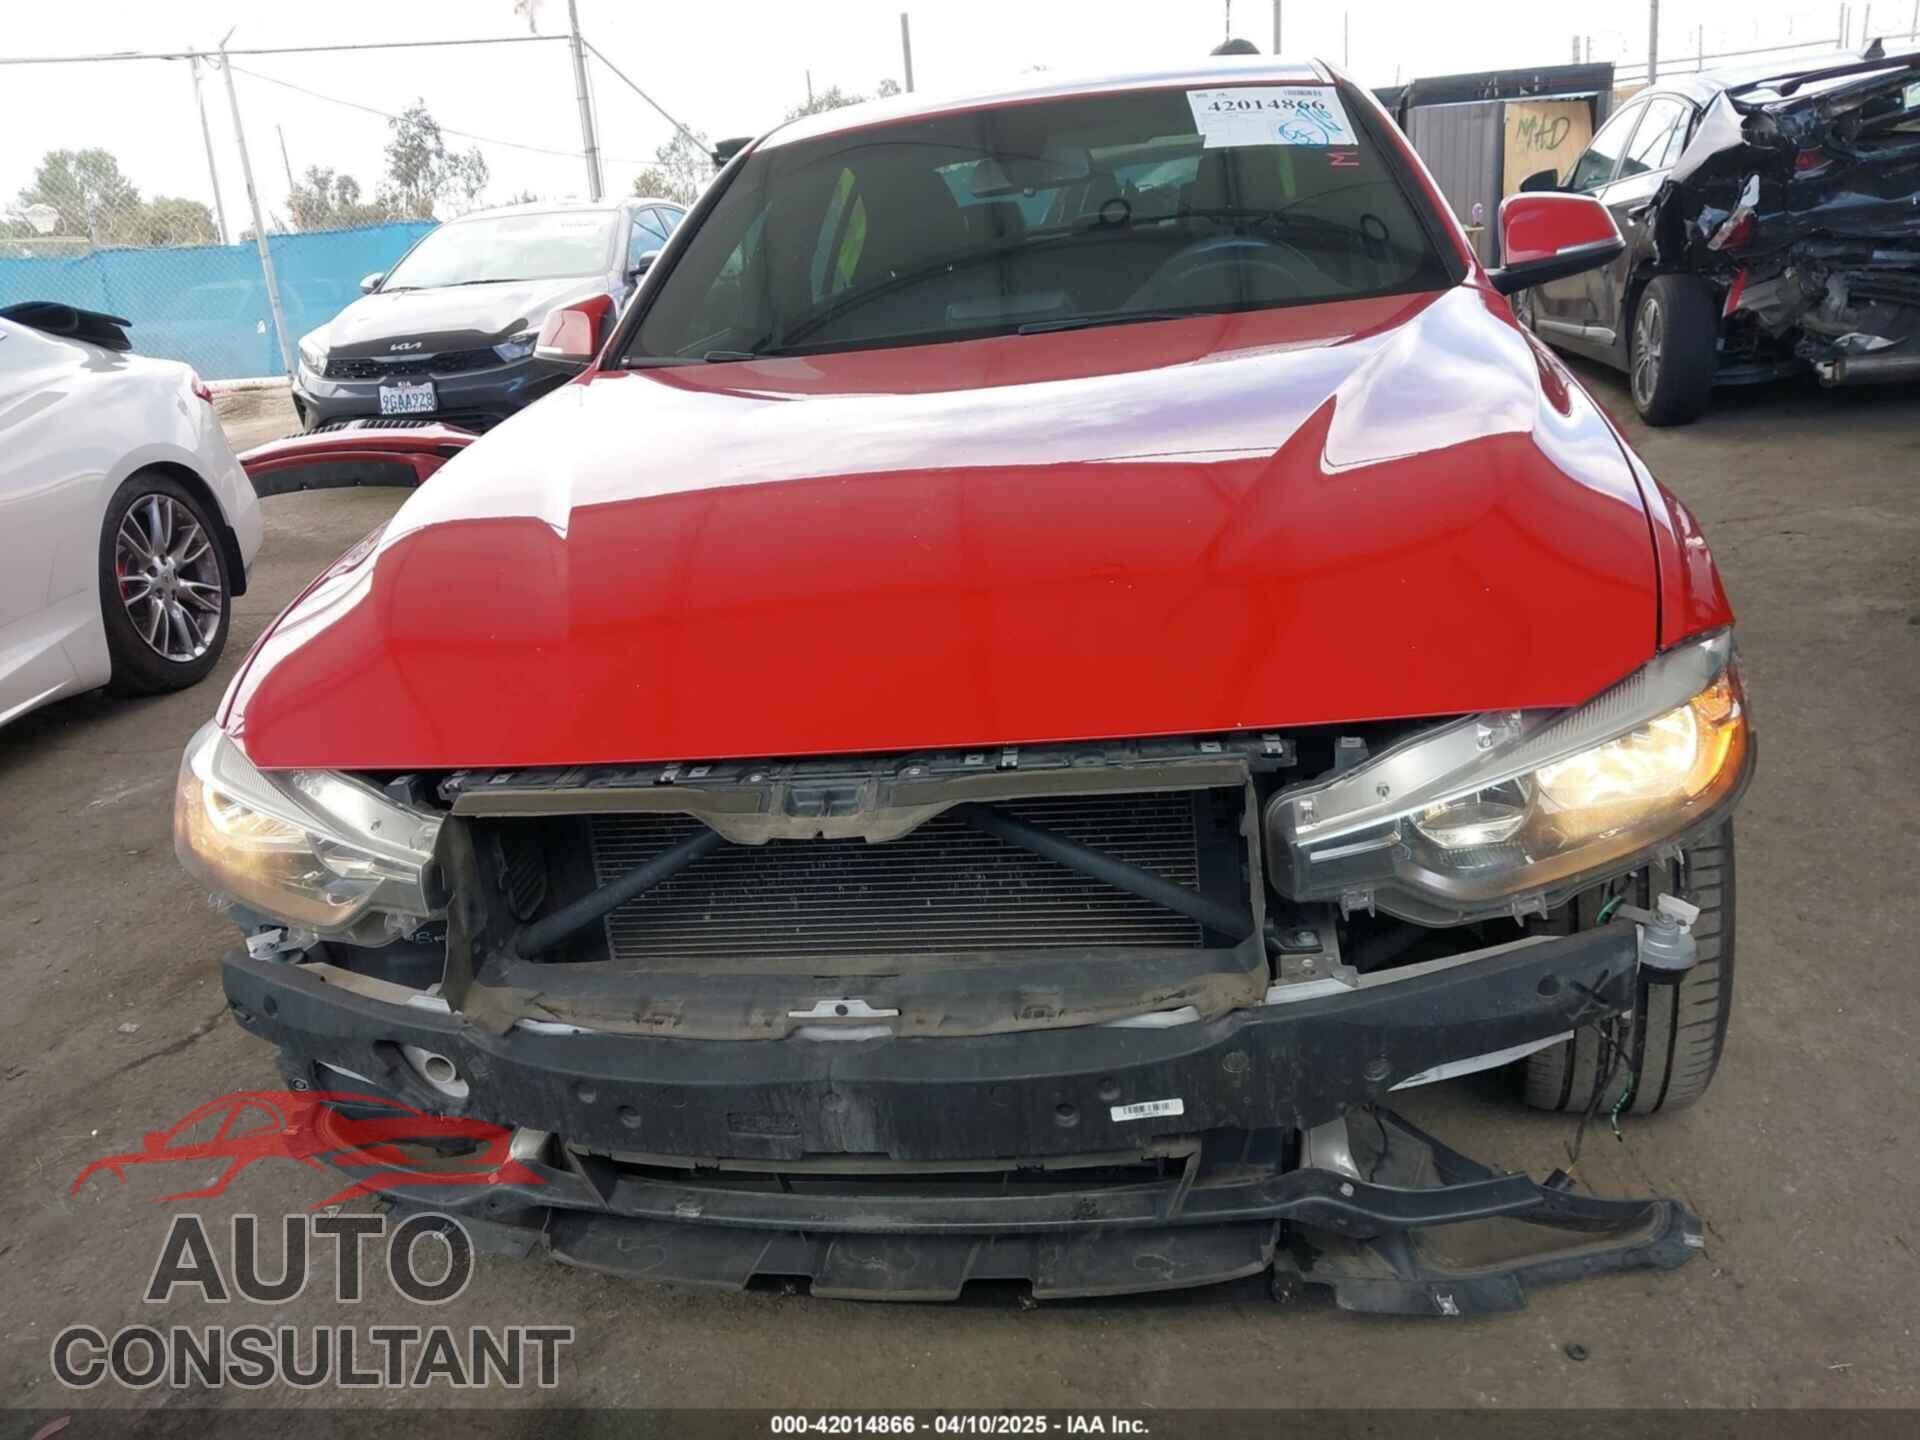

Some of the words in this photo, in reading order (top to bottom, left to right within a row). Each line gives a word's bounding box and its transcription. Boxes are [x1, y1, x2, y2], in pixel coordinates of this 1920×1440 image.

[1208, 99, 1325, 112] 42014866
[1516, 113, 1570, 151] MAD
[382, 392, 433, 409] 9GAA928
